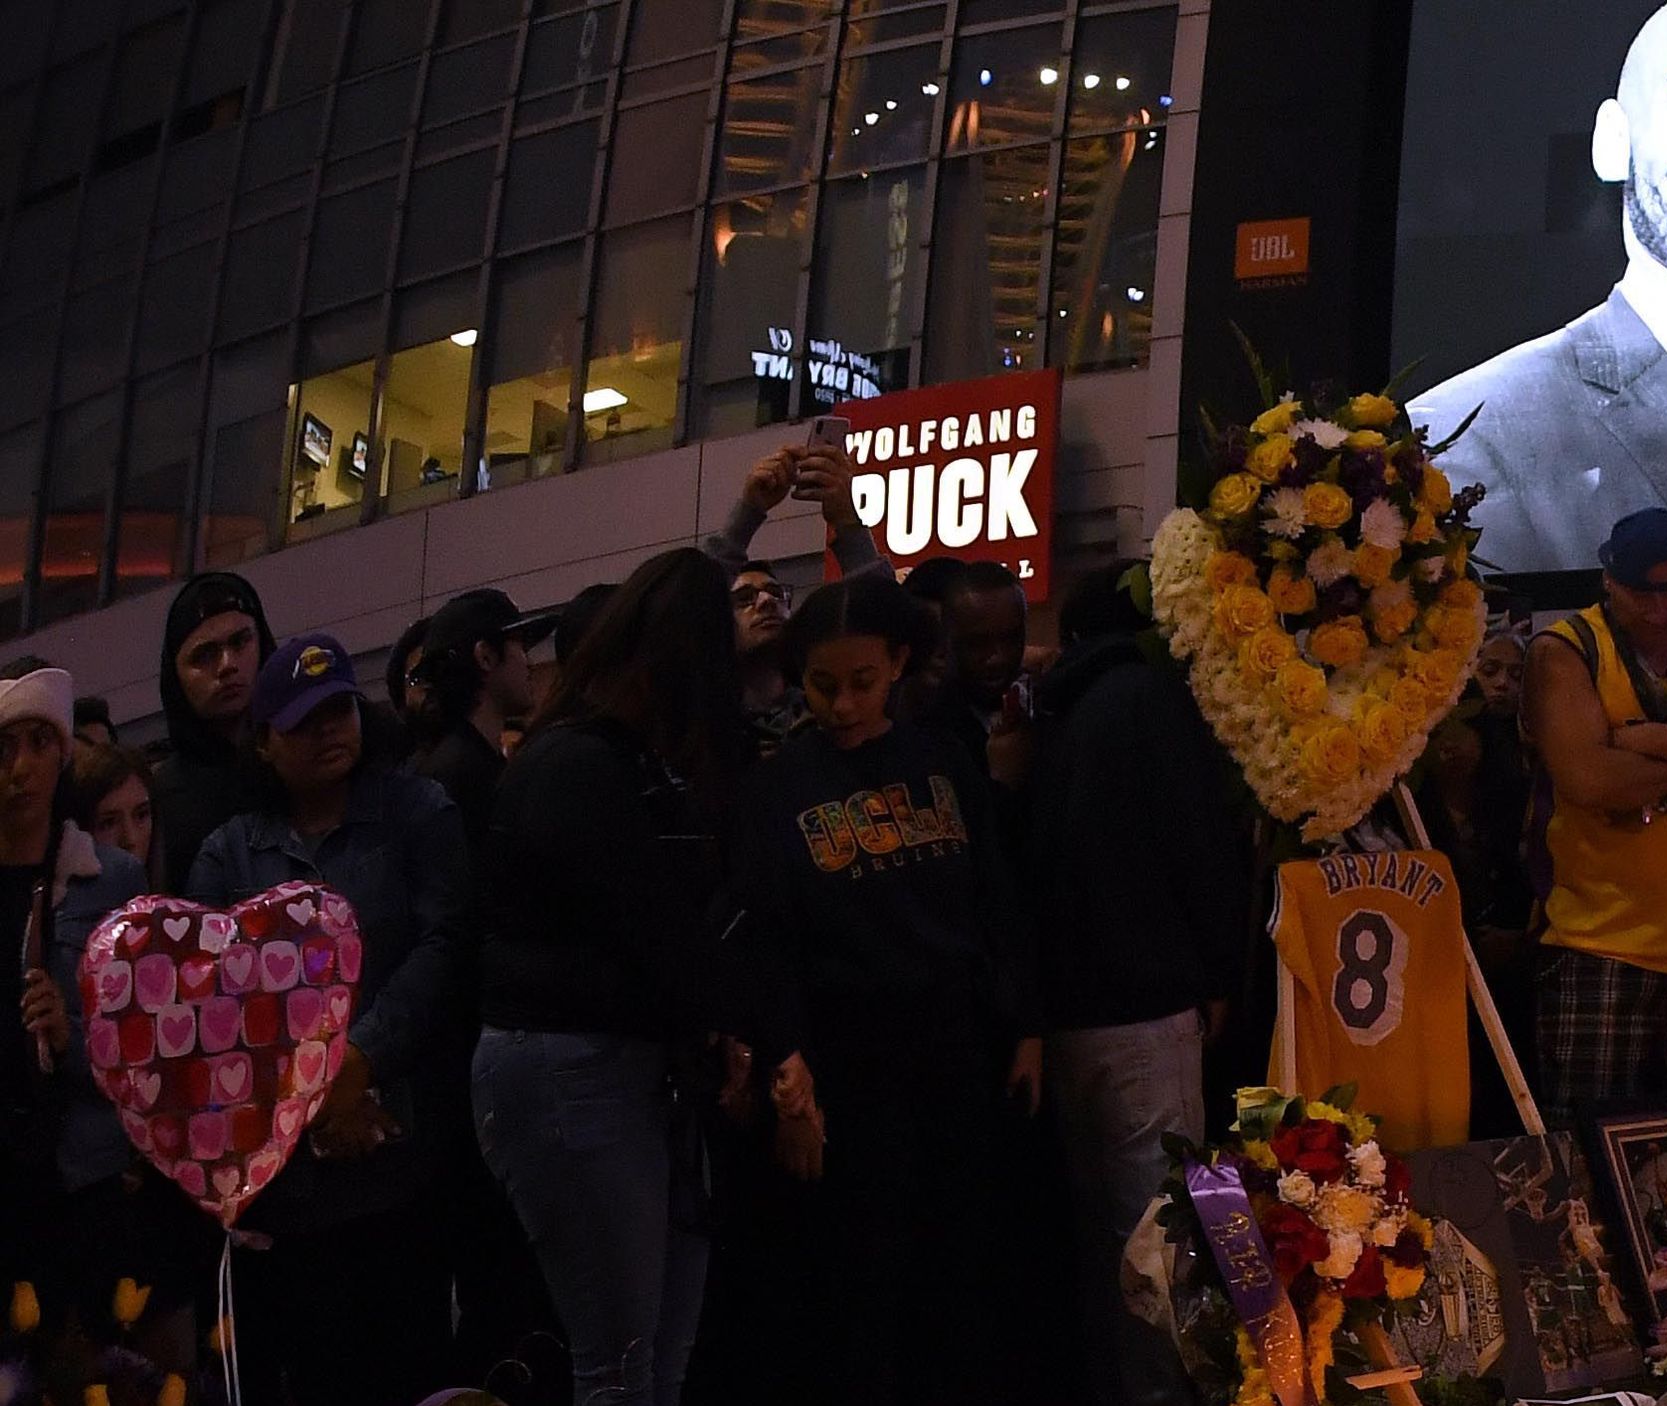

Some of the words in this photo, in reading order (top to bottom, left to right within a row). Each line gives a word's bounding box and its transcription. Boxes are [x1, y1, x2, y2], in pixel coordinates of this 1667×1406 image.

[845, 404, 1036, 465] WOLFGANG
[850, 448, 1039, 556] PUCK
[1317, 851, 1447, 909] BRYANT
[1331, 908, 1410, 1047] 8
